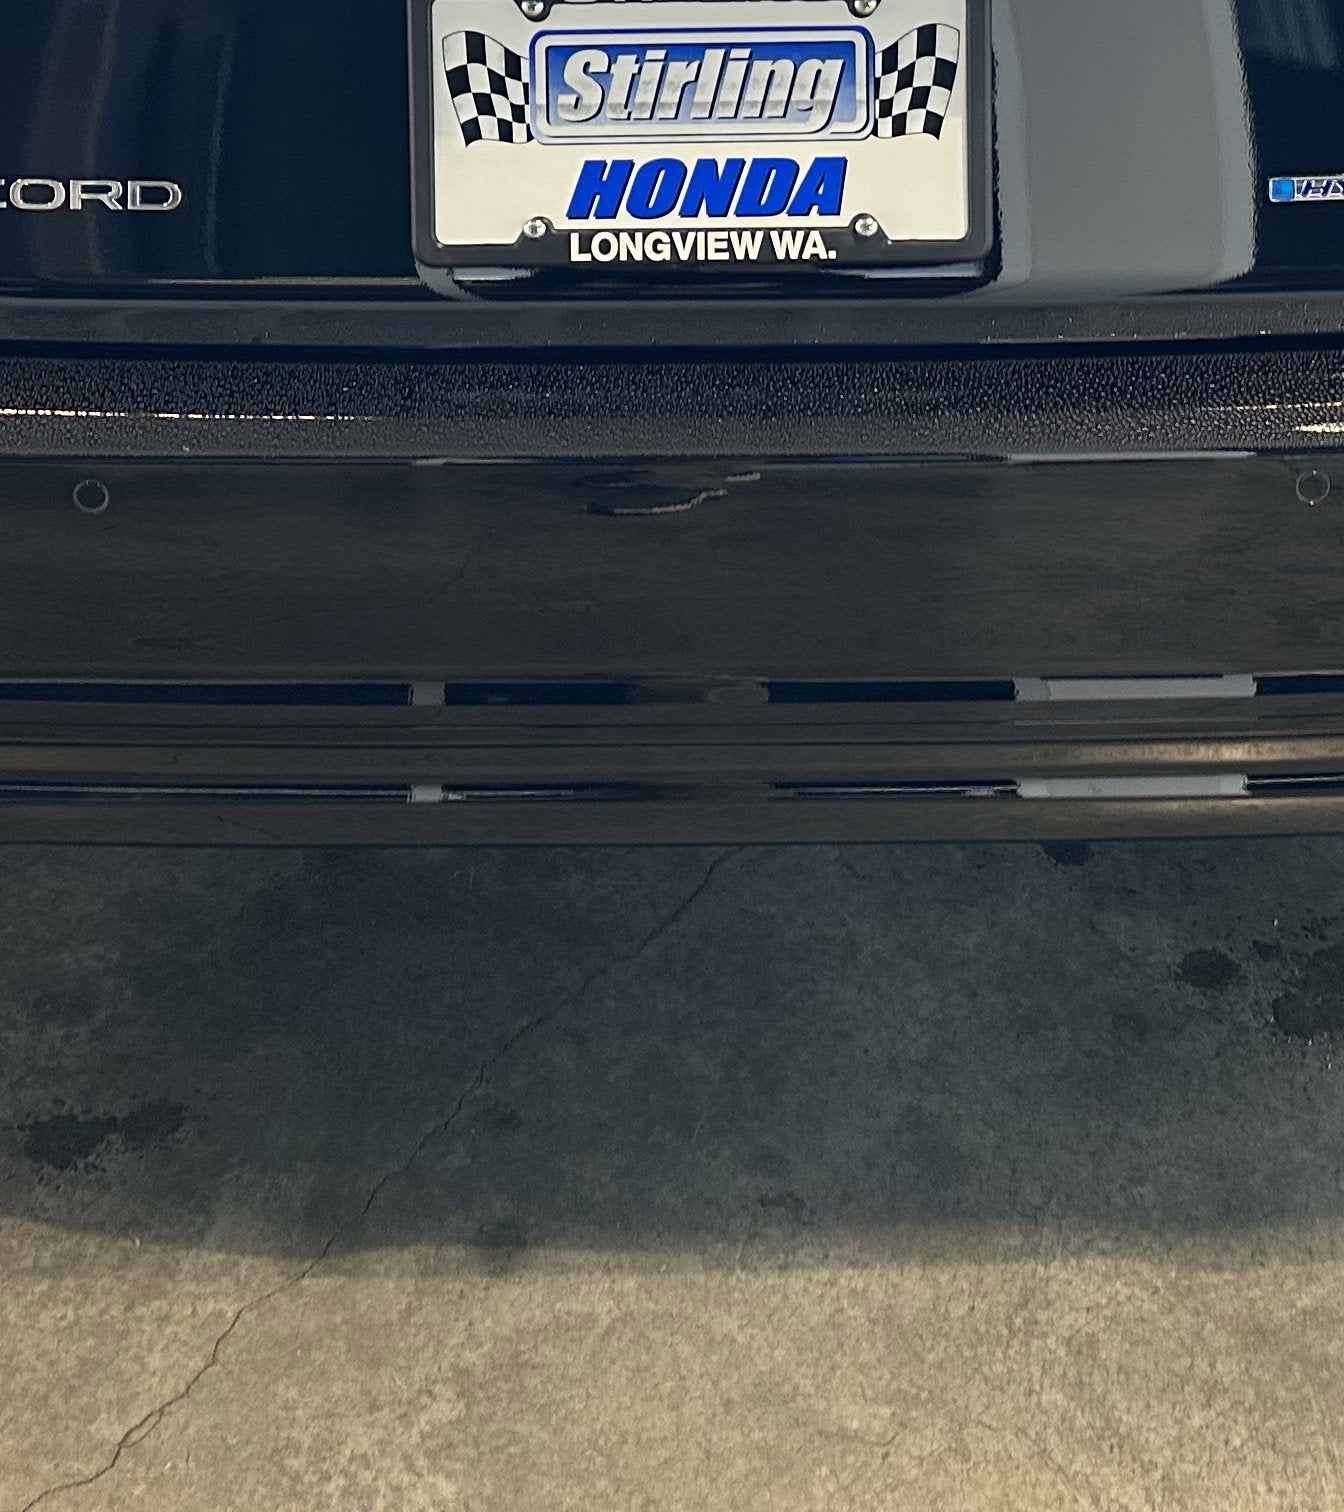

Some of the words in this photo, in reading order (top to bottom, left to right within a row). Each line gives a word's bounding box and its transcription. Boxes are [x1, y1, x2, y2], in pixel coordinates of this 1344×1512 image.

[557, 46, 845, 134] Stirling
[565, 156, 848, 220] HONDA
[569, 231, 763, 262] LONGVIEW
[768, 230, 837, 260] WA.
